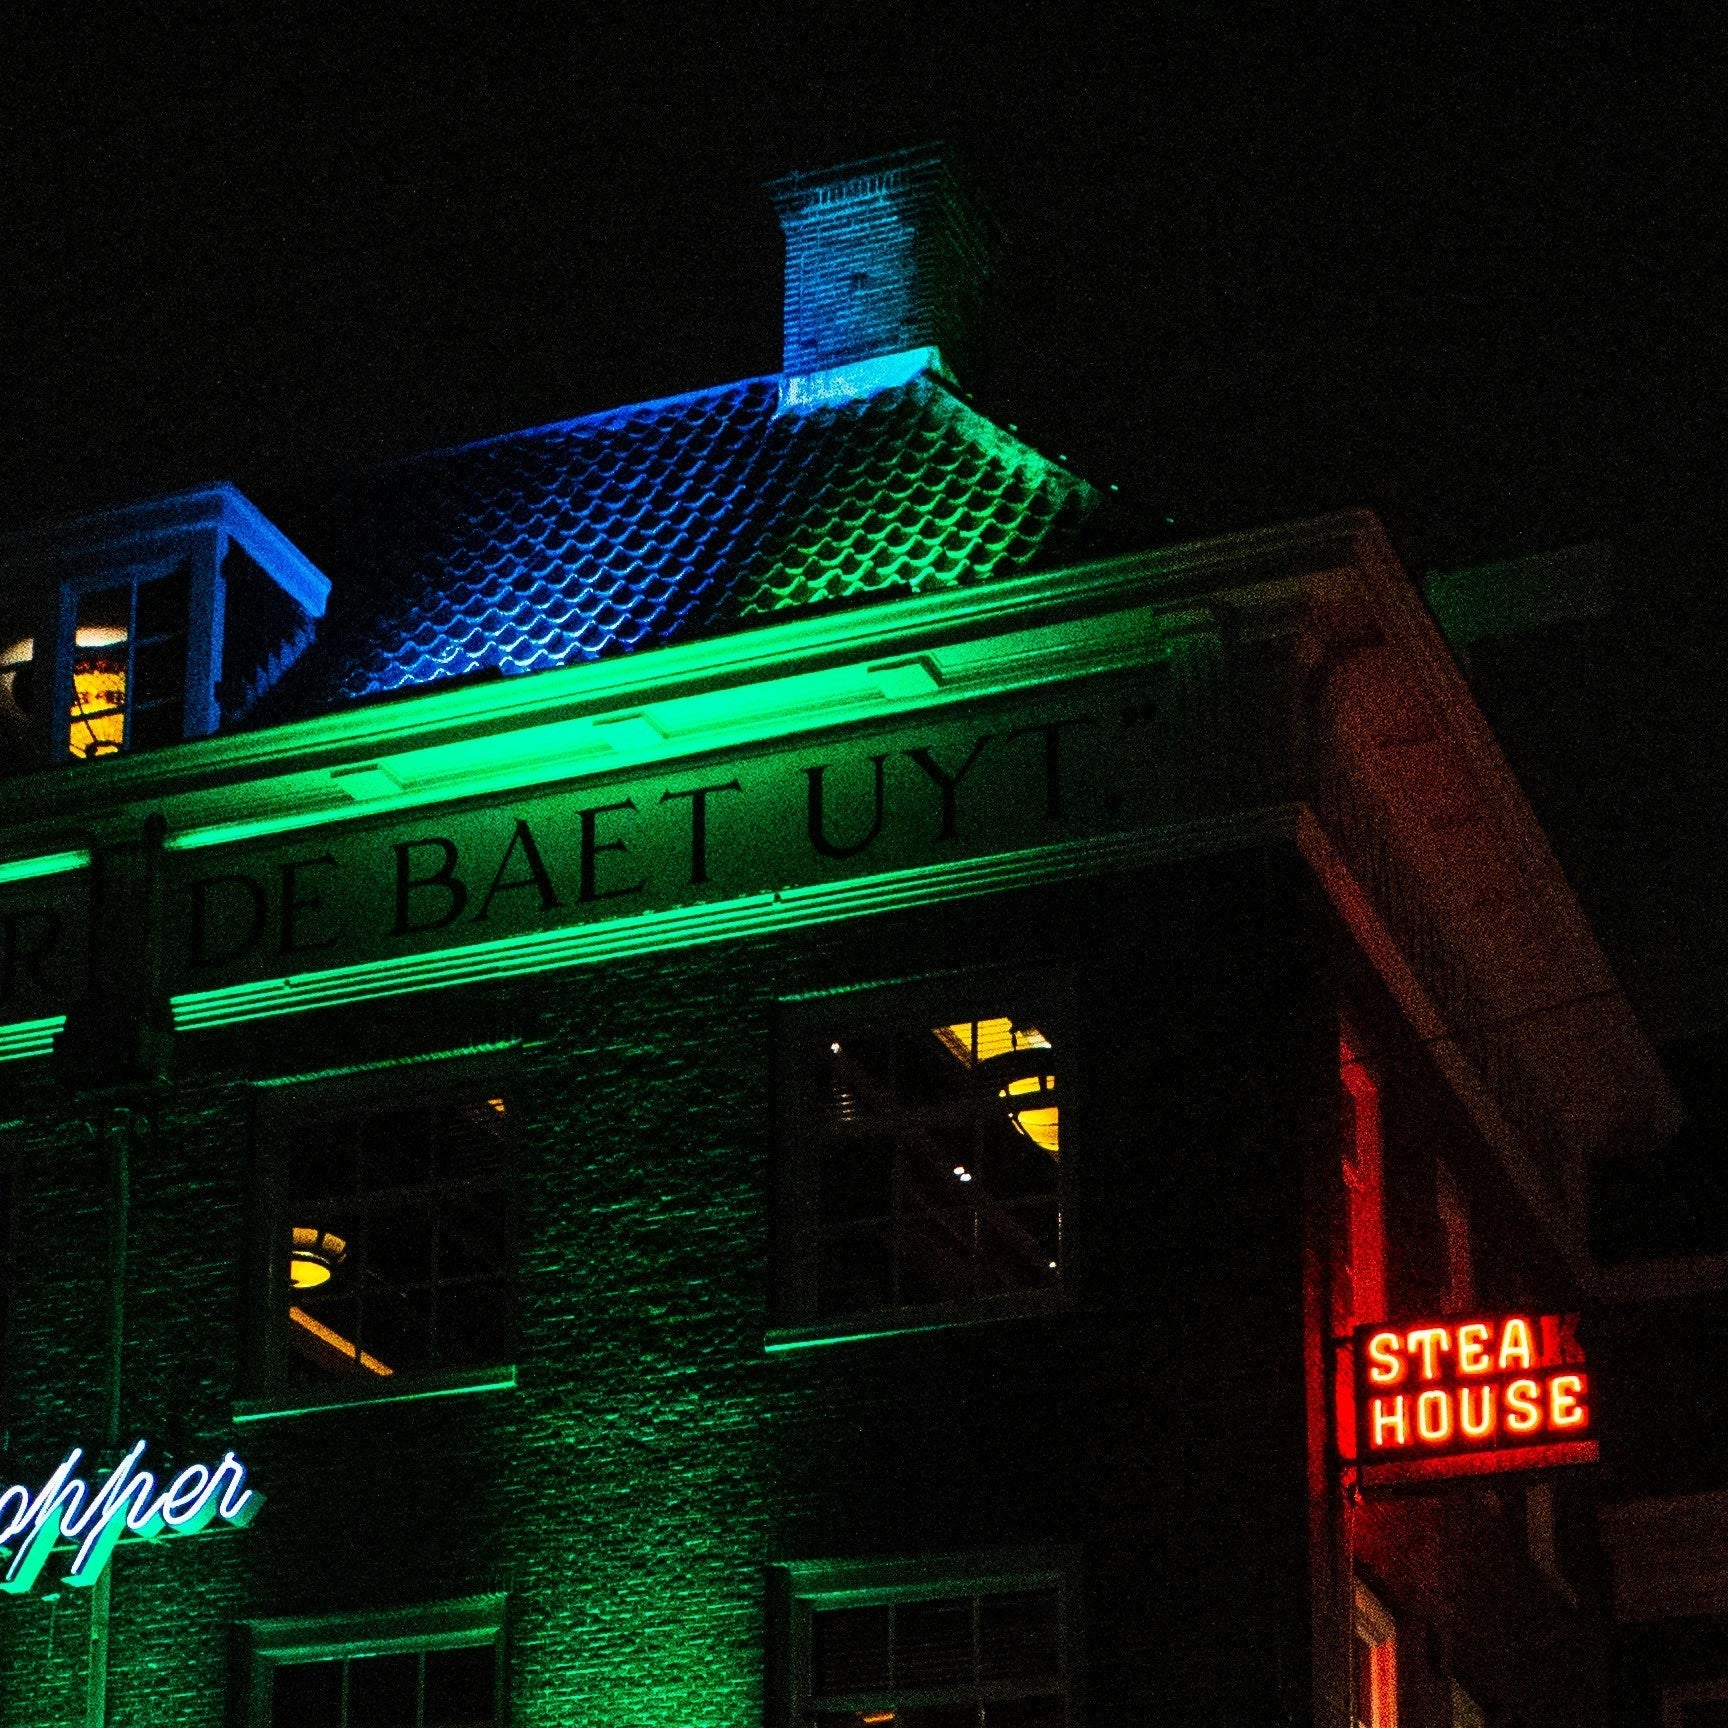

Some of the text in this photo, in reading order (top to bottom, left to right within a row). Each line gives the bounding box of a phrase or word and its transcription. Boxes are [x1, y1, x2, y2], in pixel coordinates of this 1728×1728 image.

[186, 854, 340, 971] DE
[389, 778, 742, 937] BAET
[1371, 1373, 1589, 1448] HOUSE
